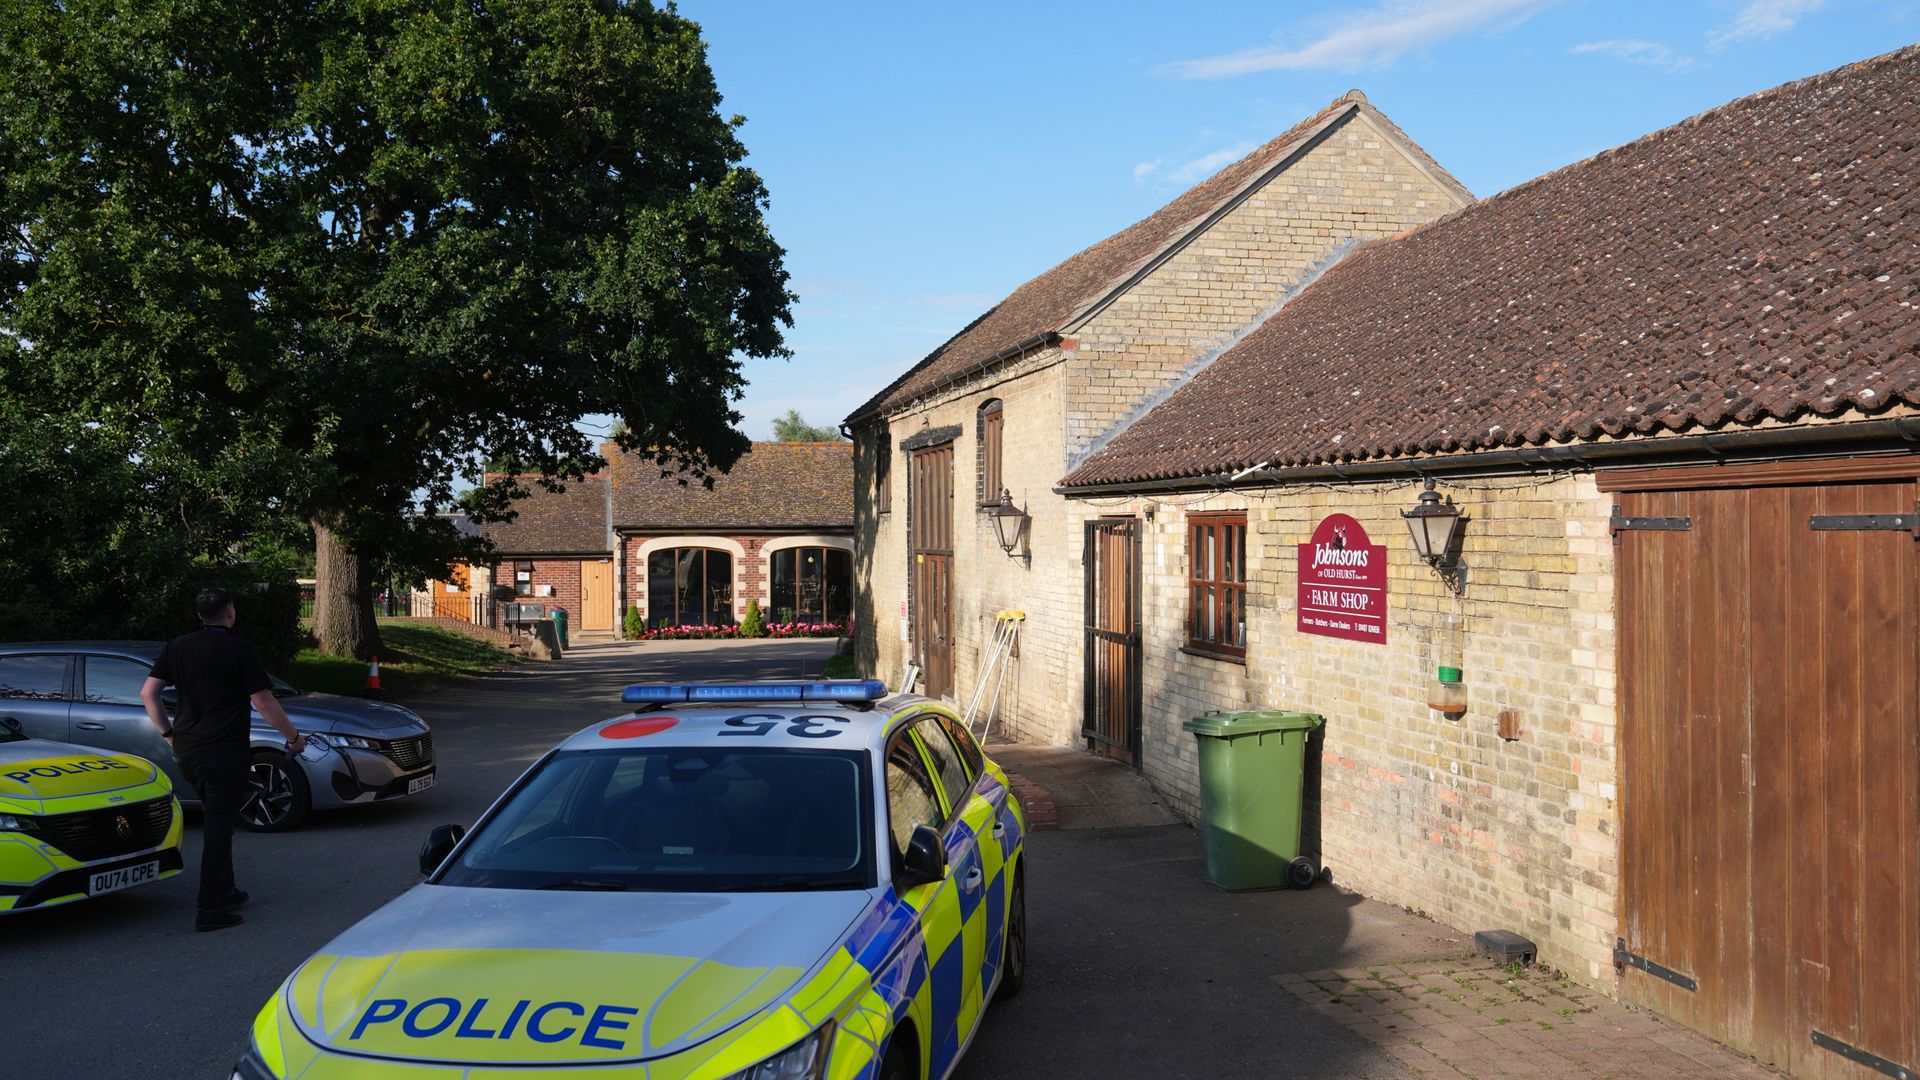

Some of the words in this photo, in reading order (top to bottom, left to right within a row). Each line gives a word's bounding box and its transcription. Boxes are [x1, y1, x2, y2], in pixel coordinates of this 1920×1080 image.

[1312, 542, 1369, 569] Johnsons
[1323, 568, 1336, 578] OLD
[1336, 568, 1357, 580] HURST
[1311, 589, 1338, 607] FARM
[1340, 592, 1369, 610] SHOP
[716, 713, 852, 739] 35
[3, 760, 130, 784] POLICE
[95, 869, 129, 891] OU74
[132, 863, 154, 882] CPE
[349, 997, 640, 1050] POLICE
